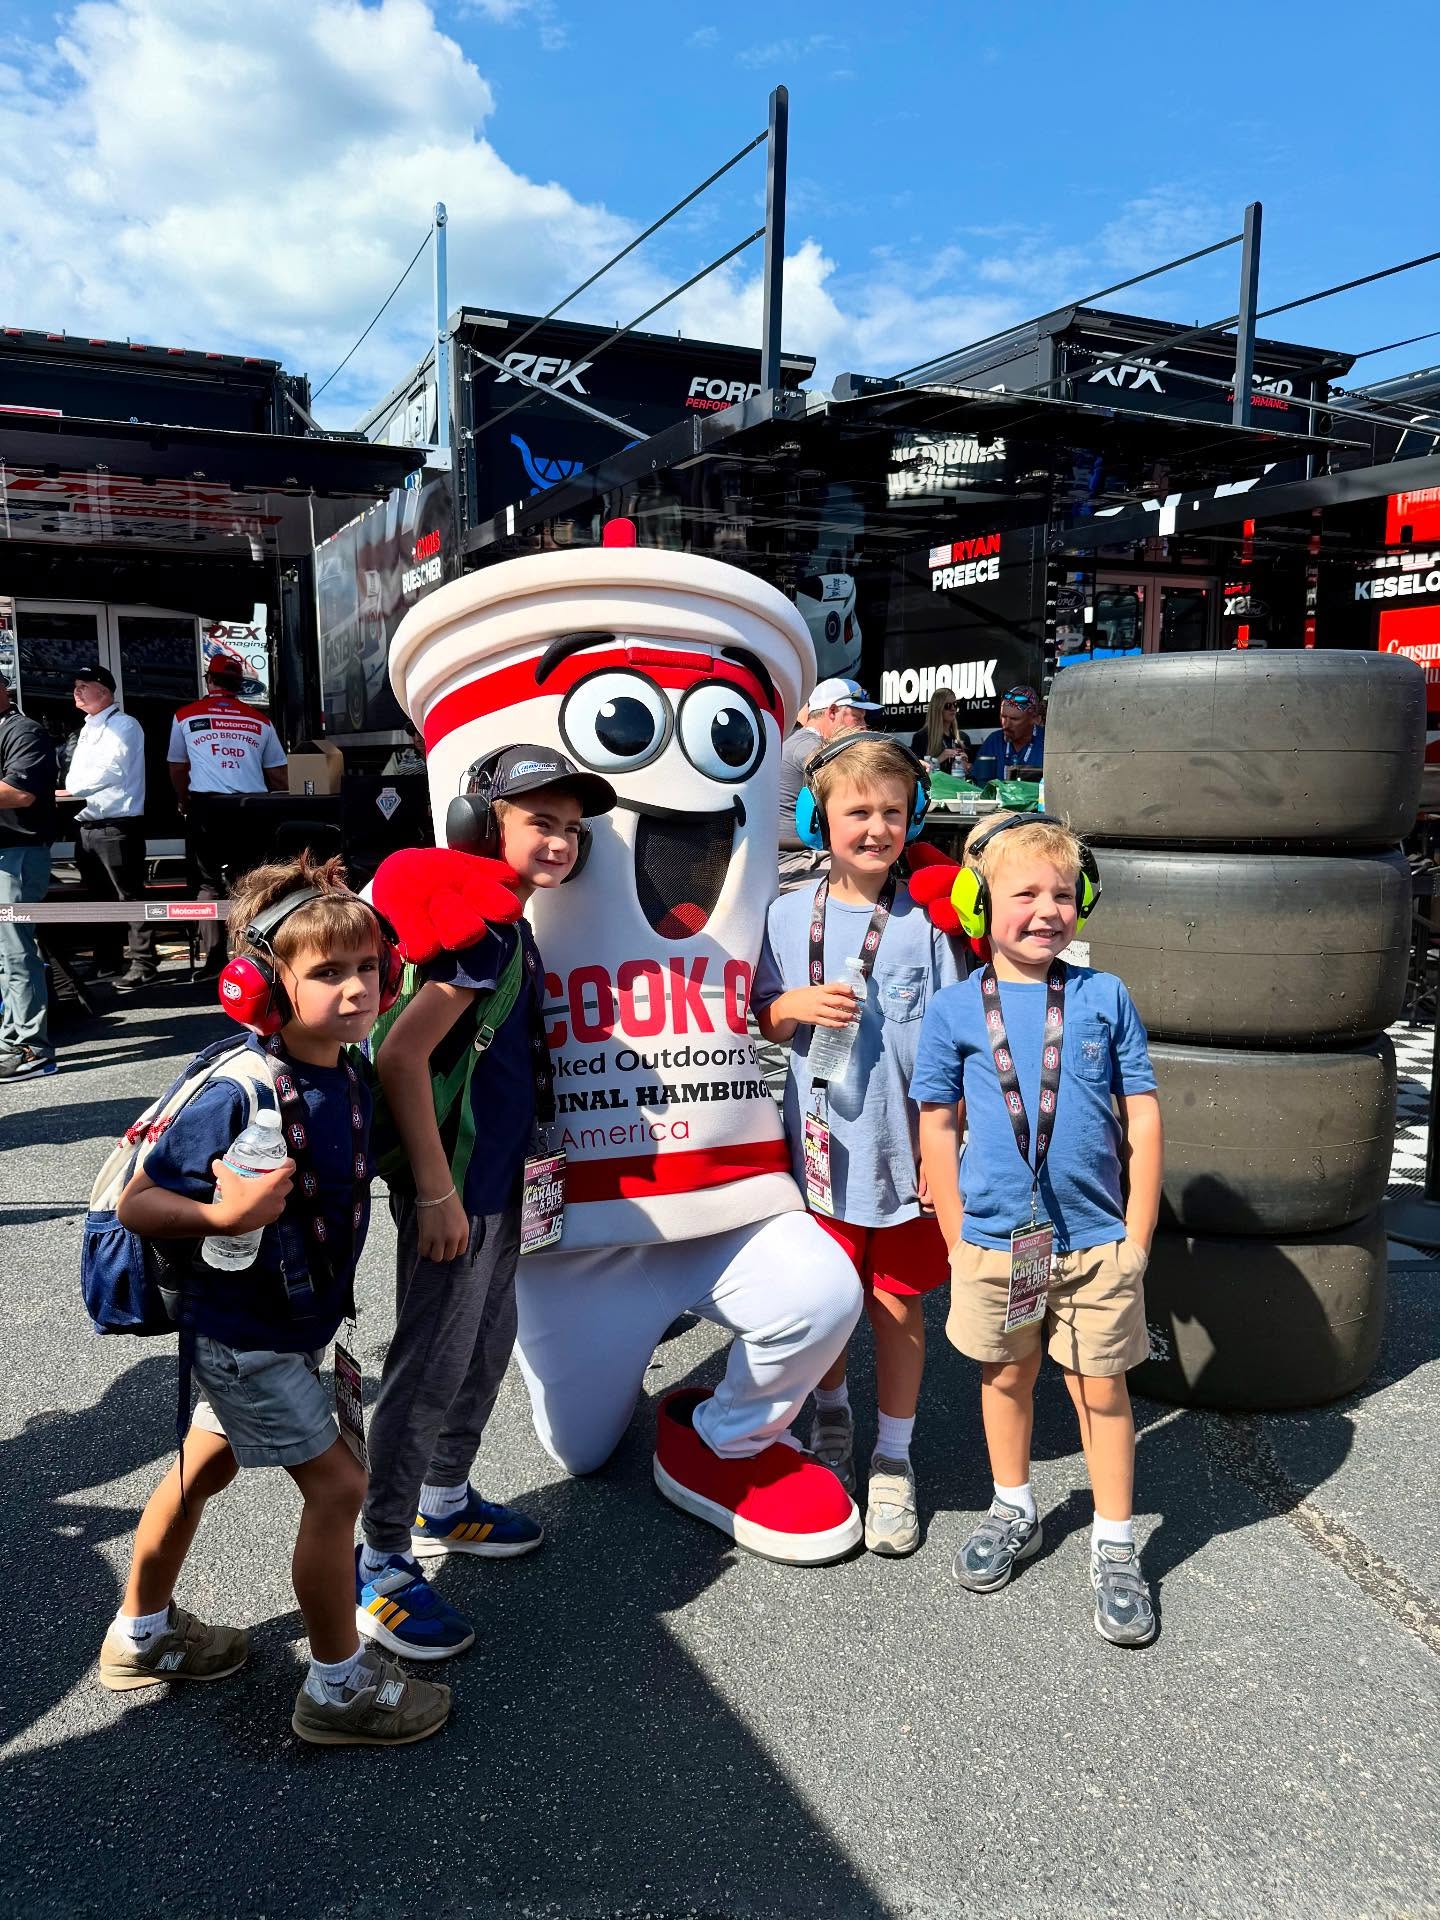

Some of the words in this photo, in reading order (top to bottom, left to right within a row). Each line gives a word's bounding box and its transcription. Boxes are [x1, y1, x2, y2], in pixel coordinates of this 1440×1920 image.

[952, 533, 1001, 562] RYAN
[401, 556, 442, 594] BUESCHER
[932, 556, 1000, 592] PREECE
[1354, 570, 1440, 601] KESELO
[208, 624, 262, 641] DEX
[222, 639, 268, 649] imaging
[880, 659, 998, 705] MOHAWK
[966, 699, 995, 711] INC.
[192, 732, 219, 747] WOOD
[171, 907, 213, 916] Motorcraft
[544, 956, 716, 1049] COOK
[723, 959, 756, 1035] O
[615, 1045, 746, 1072] Outdoors
[549, 1089, 629, 1113] INAL
[560, 1117, 690, 1150] America
[525, 1180, 563, 1205] GARAGE
[546, 1193, 562, 1209] PITS
[376, 1679, 405, 1706] N
